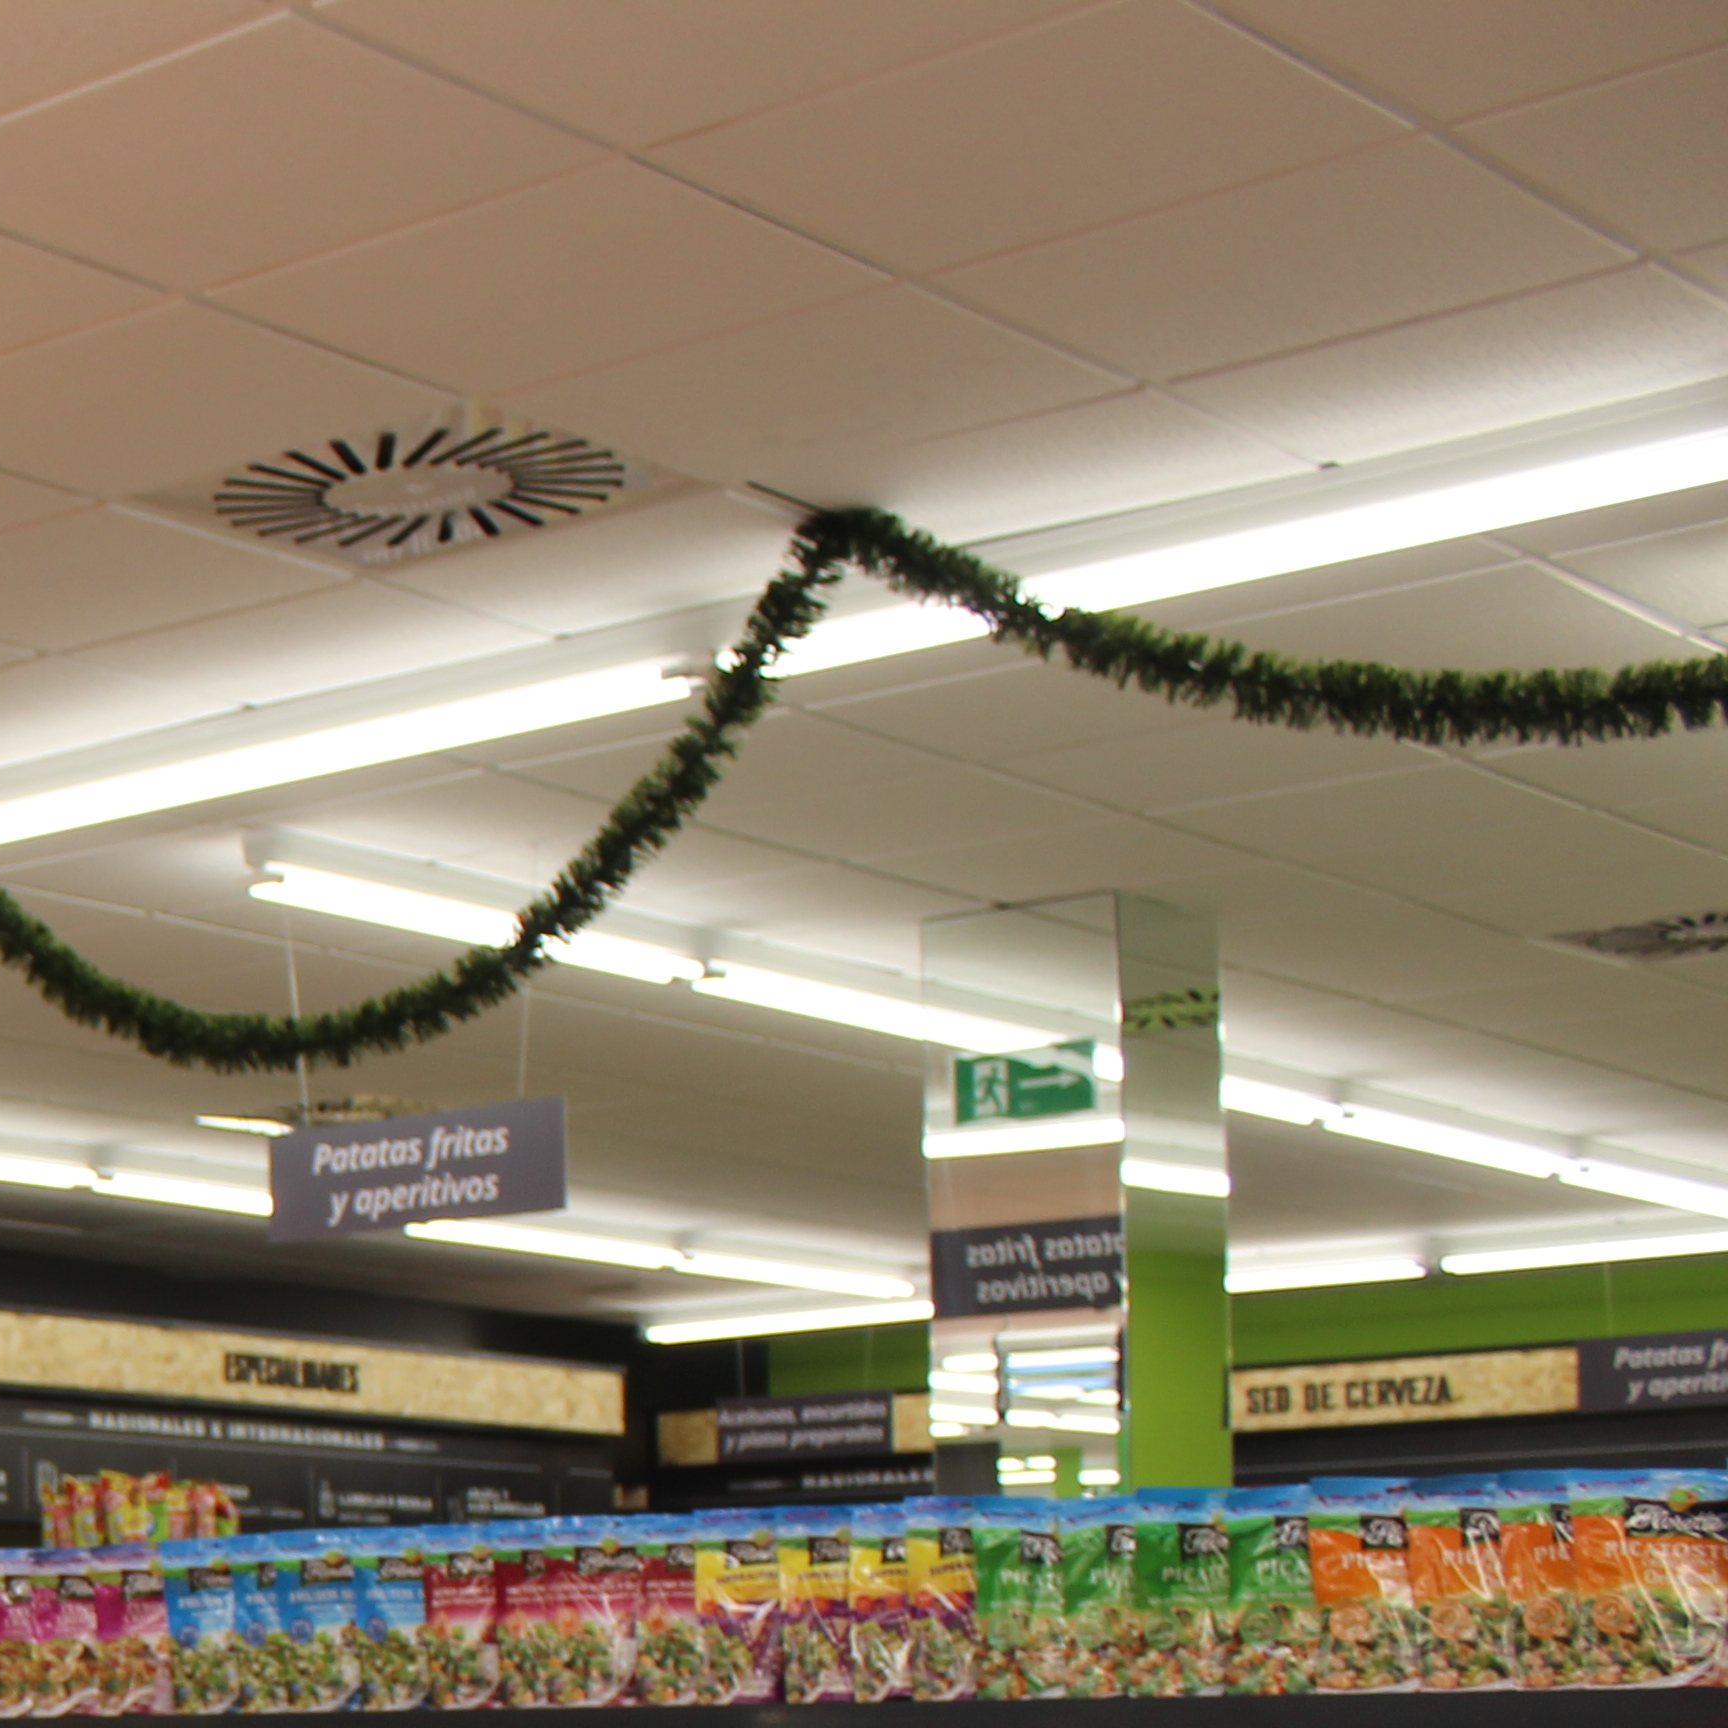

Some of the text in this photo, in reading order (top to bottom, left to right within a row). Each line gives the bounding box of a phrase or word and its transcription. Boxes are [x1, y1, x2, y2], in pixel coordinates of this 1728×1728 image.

[312, 1125, 510, 1176] Patatas fritas
[328, 1172, 500, 1228] y aperitivos
